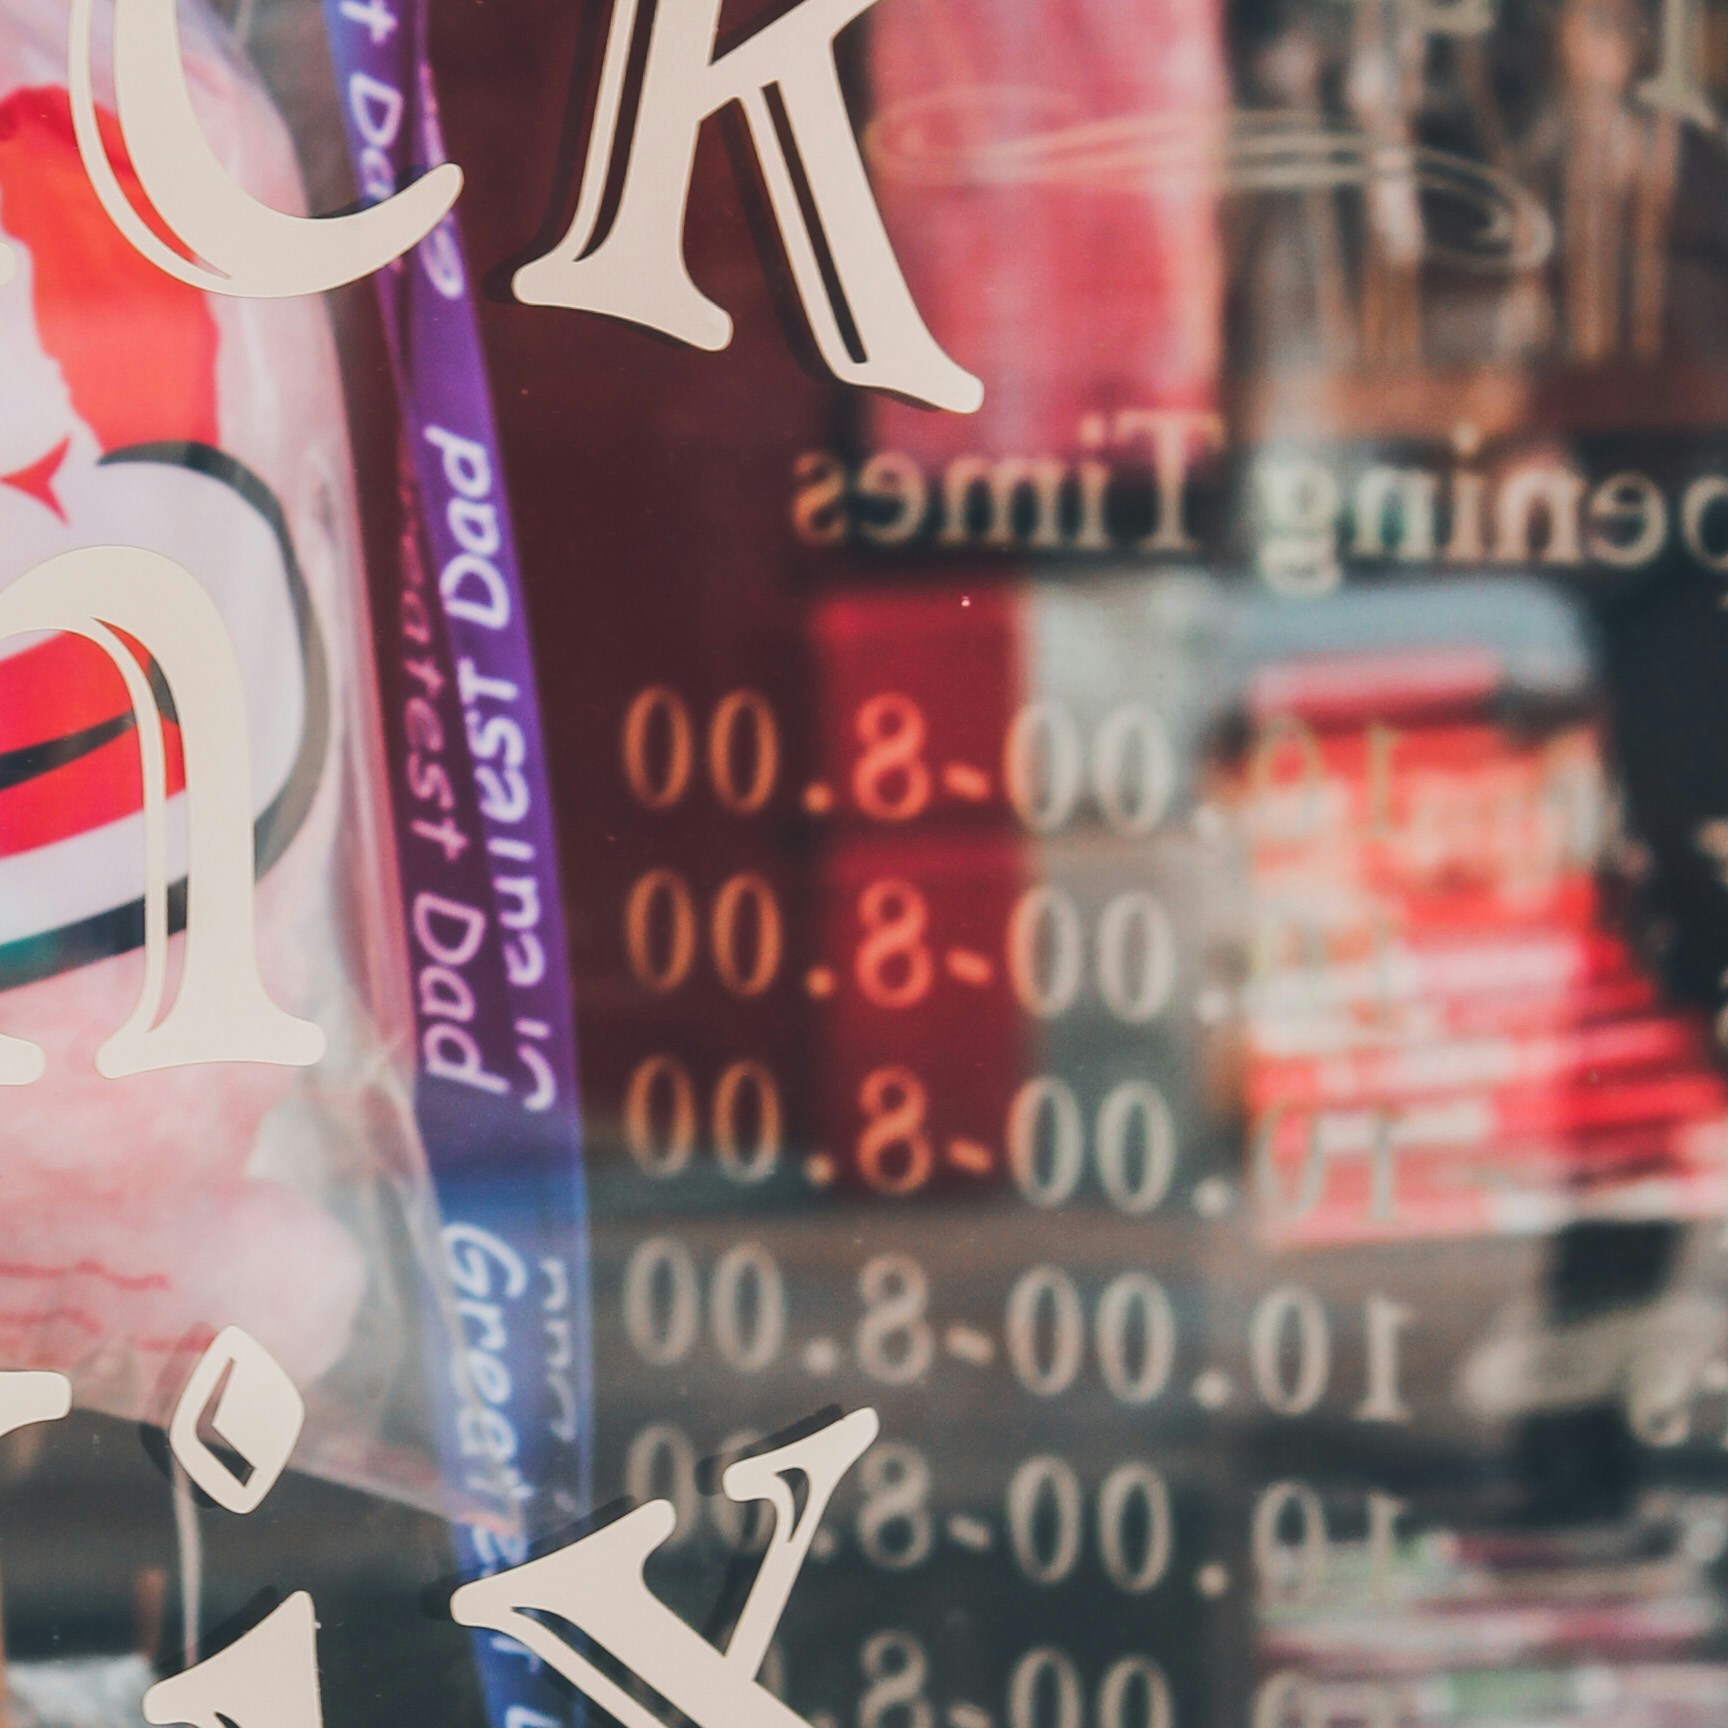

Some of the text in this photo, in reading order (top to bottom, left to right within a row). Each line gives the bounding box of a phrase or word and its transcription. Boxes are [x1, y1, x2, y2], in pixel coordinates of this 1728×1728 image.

[350, 72, 407, 212] Da
[422, 422, 510, 632] Dad
[412, 888, 510, 1095] Dad
[440, 1222, 542, 1674] Greatet
